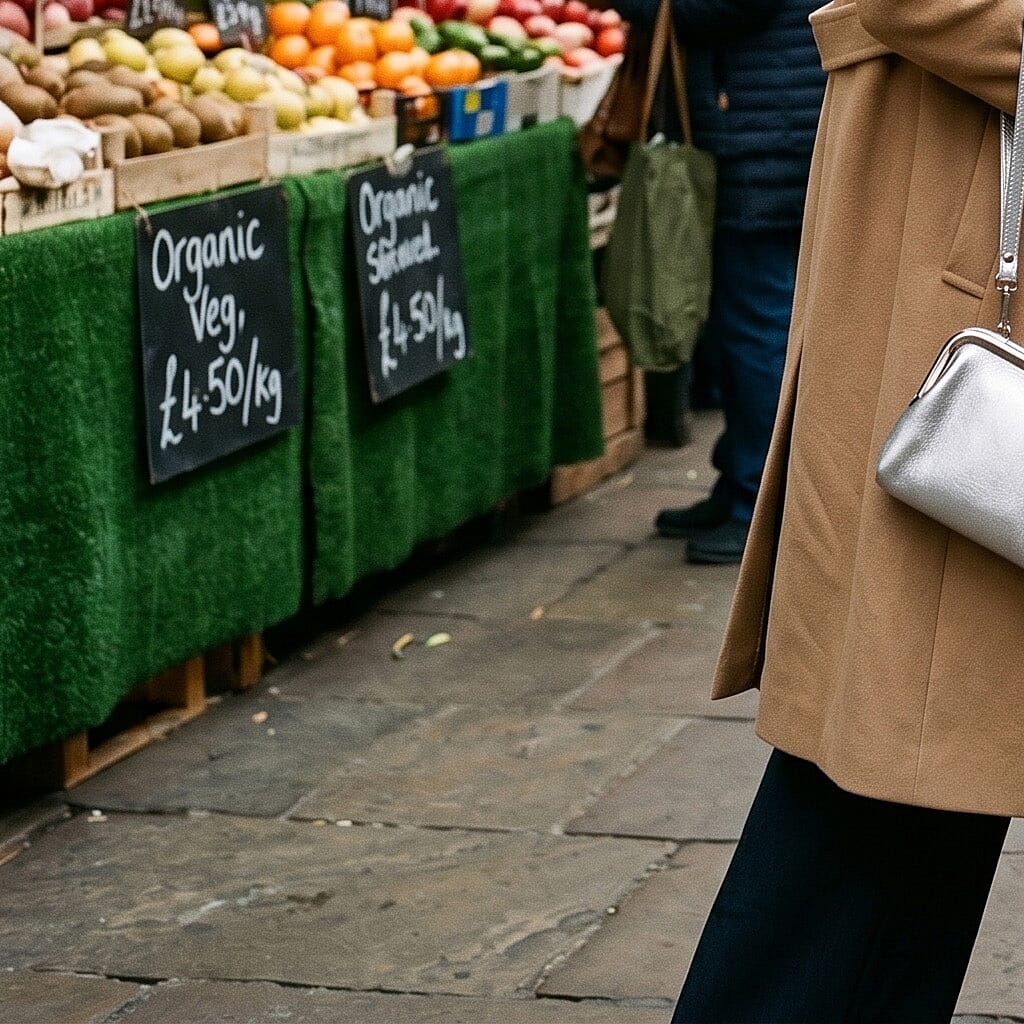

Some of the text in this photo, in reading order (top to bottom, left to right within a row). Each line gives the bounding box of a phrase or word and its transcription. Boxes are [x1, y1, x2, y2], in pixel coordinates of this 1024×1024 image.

[152, 209, 266, 304] Organic
[359, 170, 439, 248] Organic
[159, 335, 282, 450] £4.50/kg
